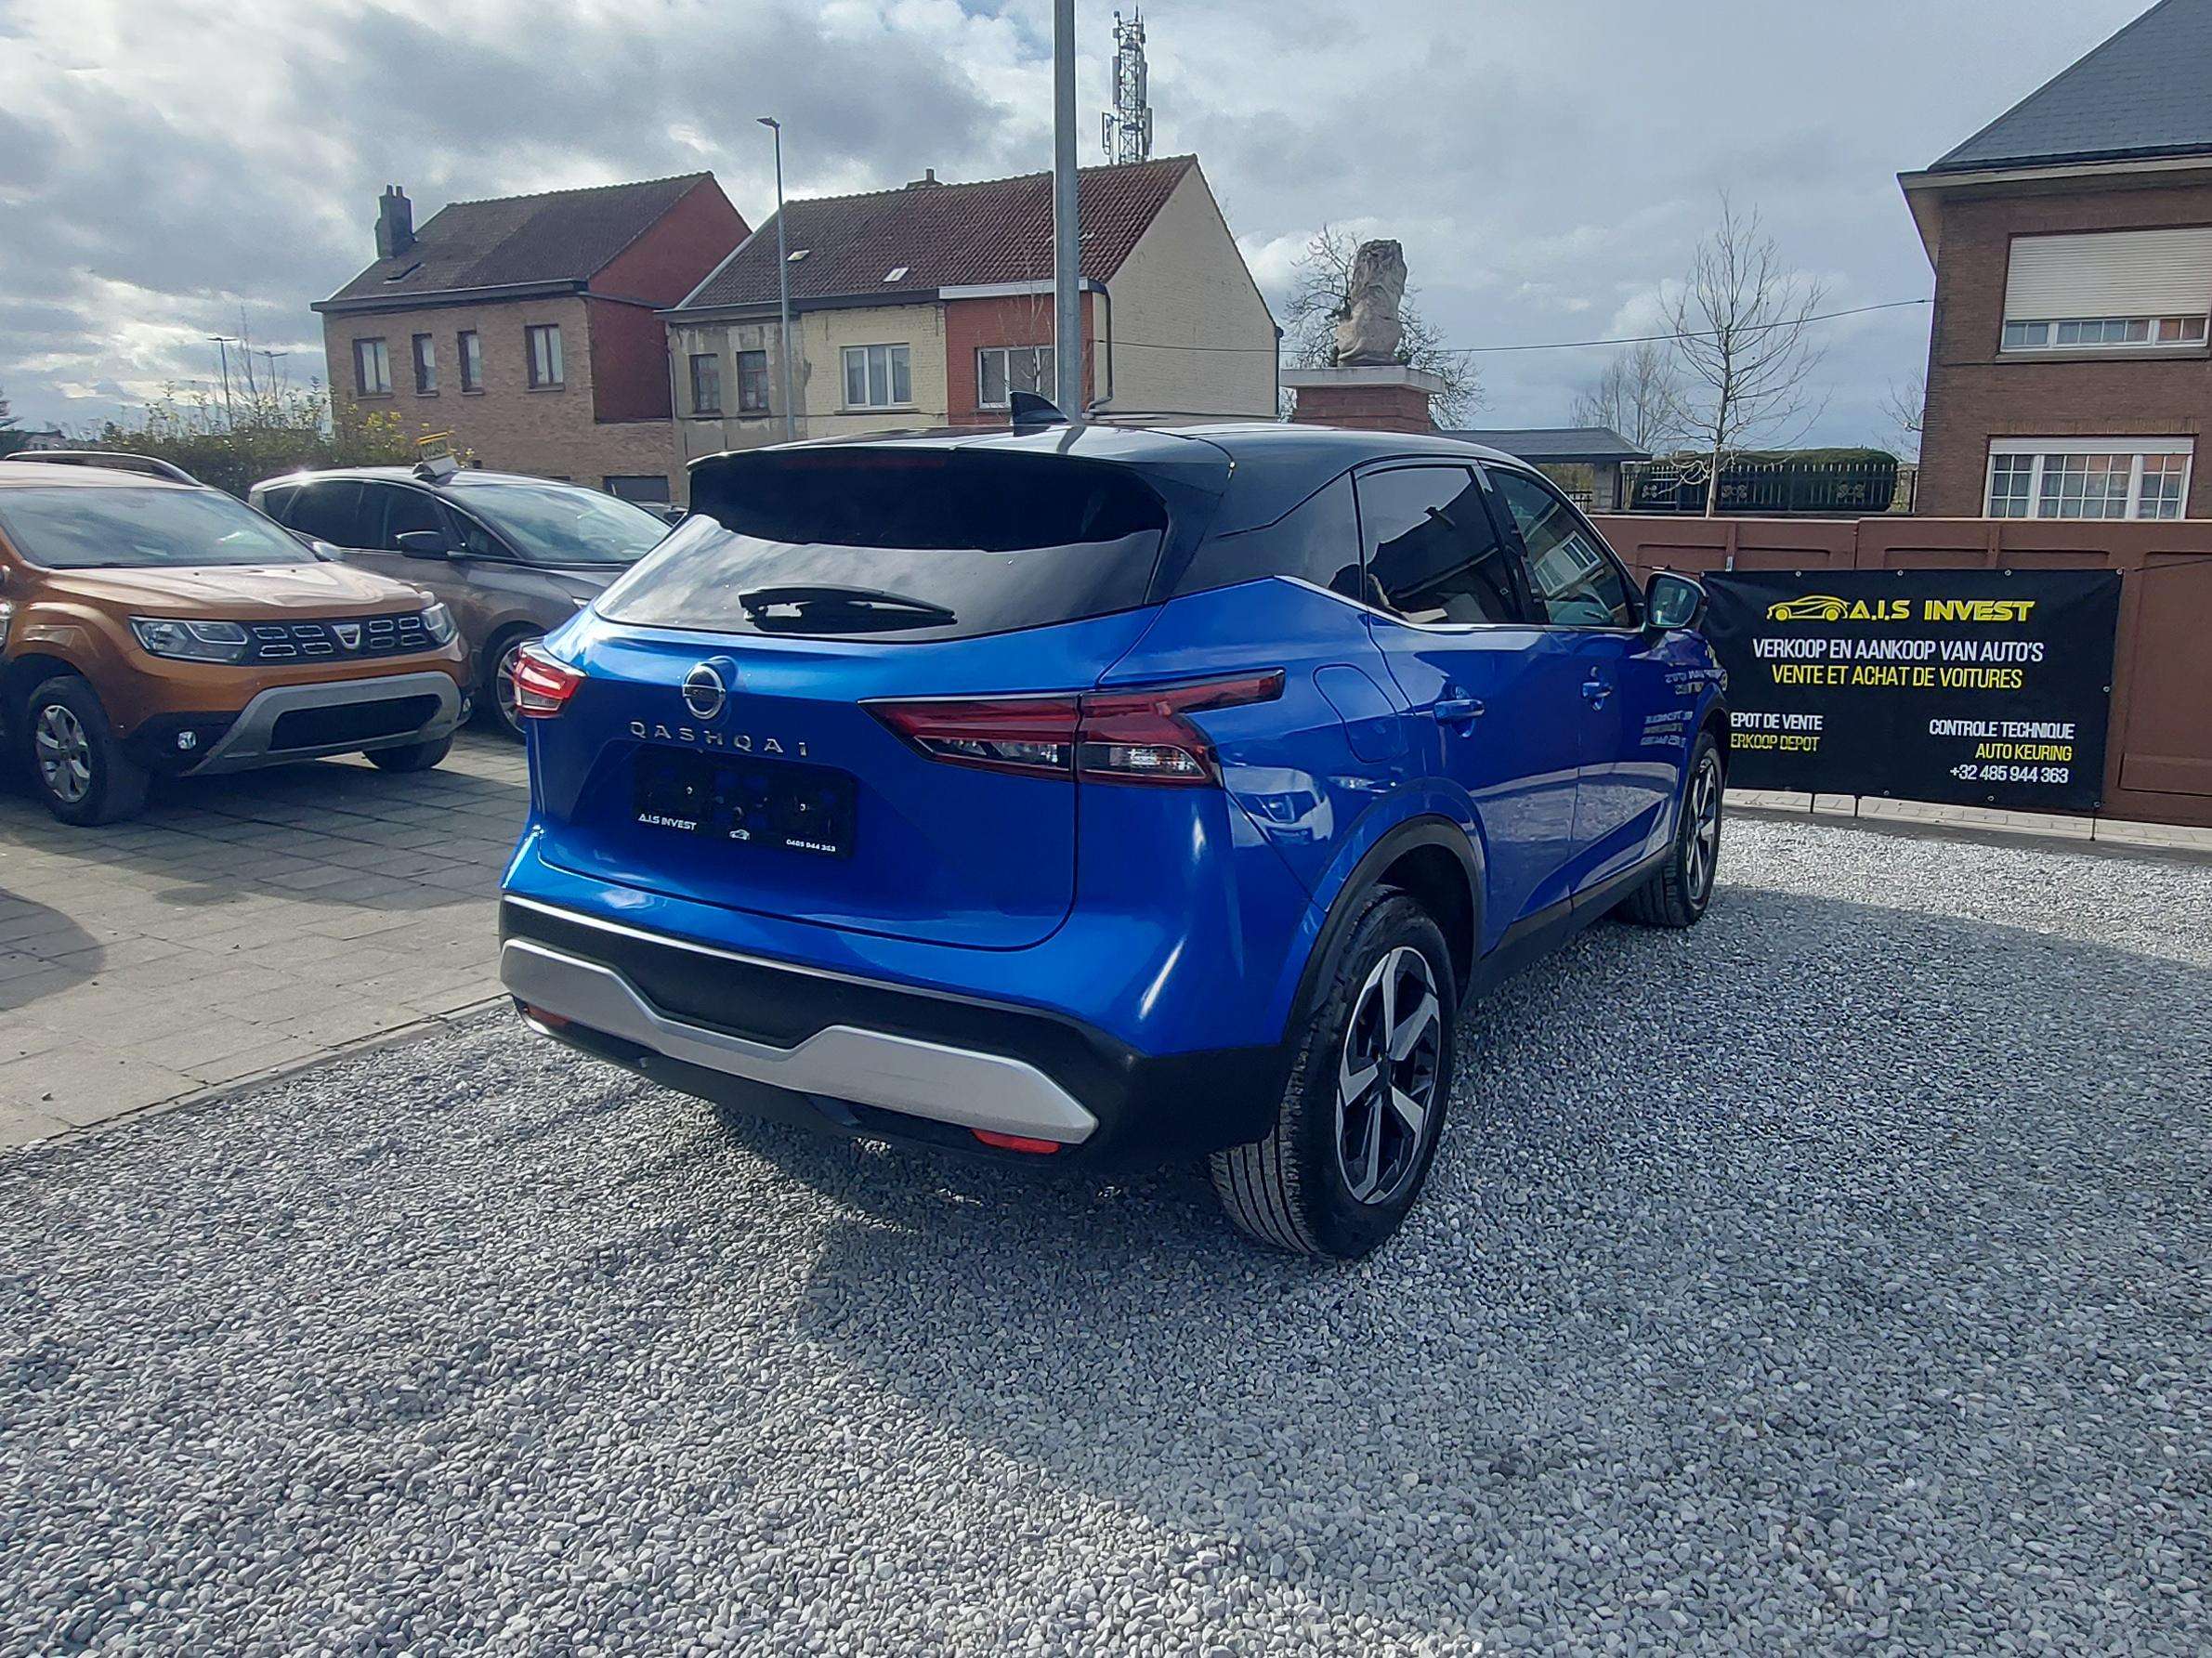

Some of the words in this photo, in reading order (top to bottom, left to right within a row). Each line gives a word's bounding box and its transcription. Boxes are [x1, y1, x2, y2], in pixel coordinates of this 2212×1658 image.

[1849, 599, 1911, 621] A.I.S
[1923, 600, 2035, 622] INVEST
[1752, 638, 1827, 659] VERKOOP
[1829, 639, 1852, 659] EN
[1854, 639, 1936, 660] AANKOOP
[1940, 640, 1978, 661] VAN
[1980, 641, 2045, 662] AUTO'S
[1772, 664, 1825, 684] VENTE
[1827, 665, 1849, 685] ET
[1852, 665, 1910, 686] ACHAT
[1912, 666, 1936, 686] DE
[1939, 667, 2023, 688] VOITURES
[1730, 712, 1762, 728] EPOT
[1763, 712, 1780, 729] DE
[1782, 713, 1824, 731] VENTE
[1929, 718, 1998, 738] CONTROLE
[1999, 721, 2076, 740] TECHNIQUE
[630, 721, 807, 757] QASHQAI
[1731, 733, 1778, 750] ERKOOP
[1779, 735, 1821, 751] DEPOT
[1974, 743, 2013, 760] AUTO
[2014, 745, 2074, 762] KEURING
[1949, 764, 1978, 781] +32
[1979, 764, 2009, 781] 485
[2009, 765, 2038, 783] 944
[2040, 766, 2069, 784] 363
[661, 816, 698, 831] INVEST
